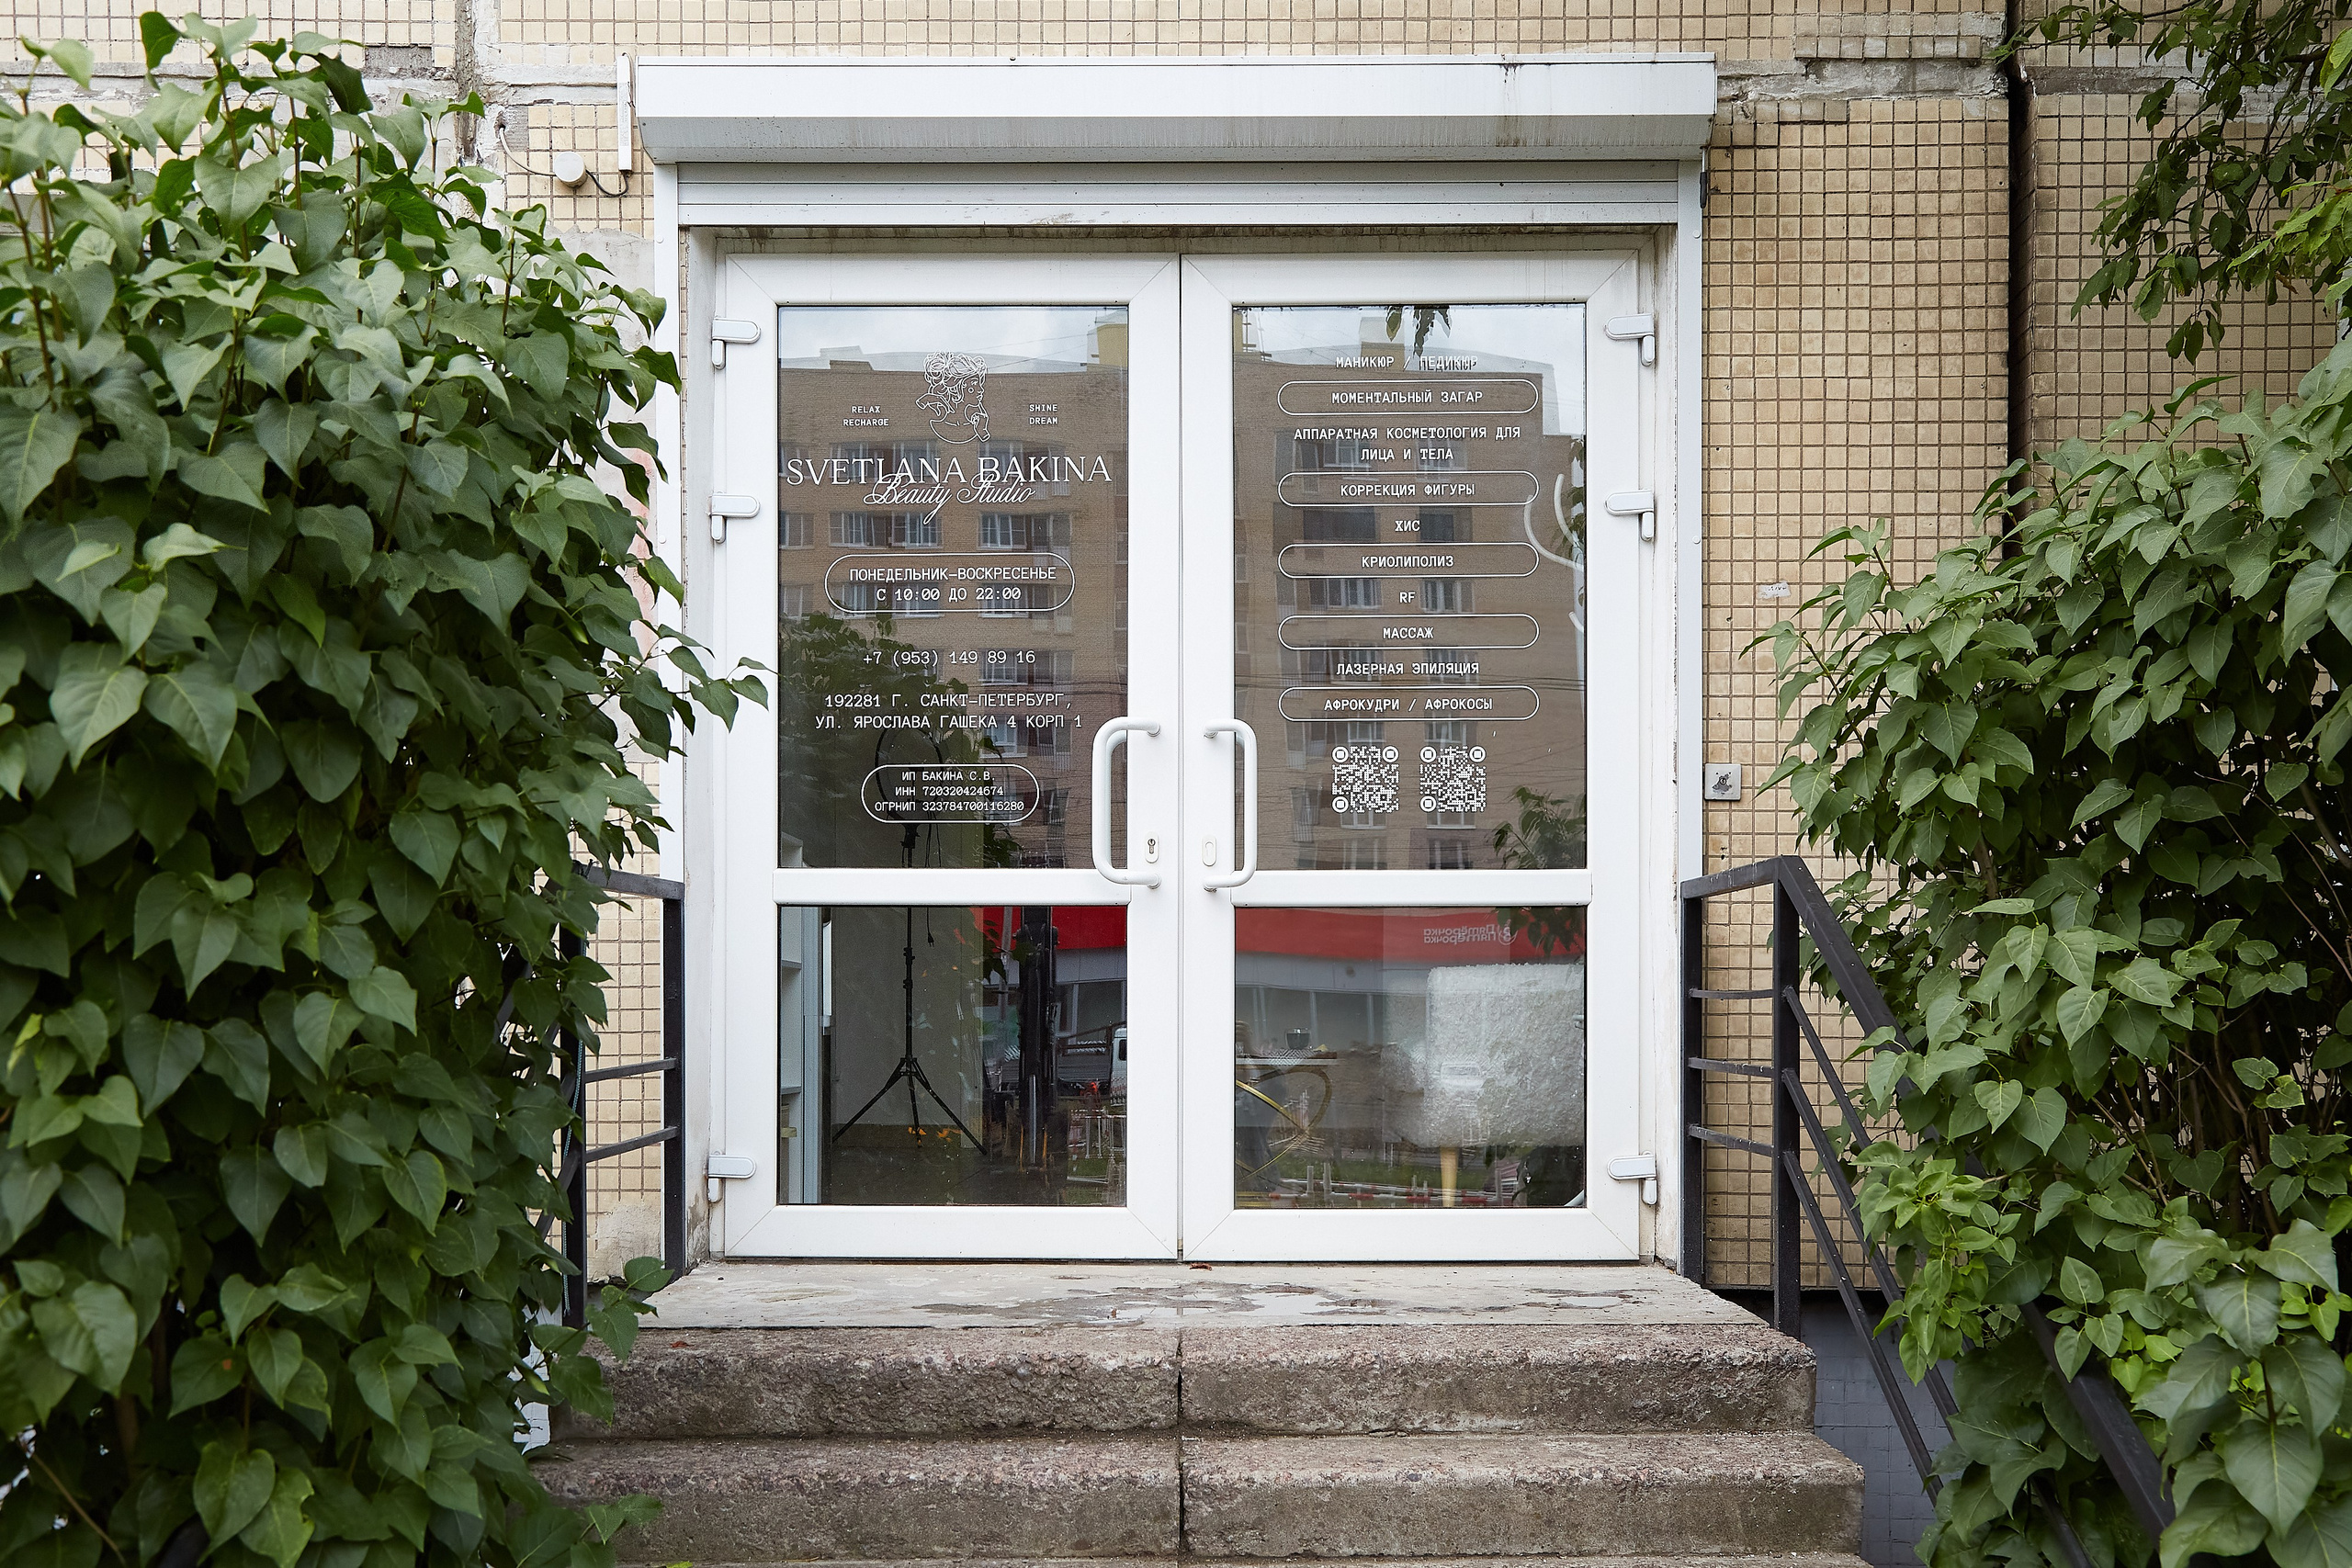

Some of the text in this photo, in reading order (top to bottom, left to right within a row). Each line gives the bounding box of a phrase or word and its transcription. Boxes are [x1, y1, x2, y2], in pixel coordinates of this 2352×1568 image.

[1336, 356, 1395, 368] МАНИКЮР
[1419, 355, 1478, 368] ПЕДИКЮР
[1331, 389, 1483, 404] МОМЕНТАЛЬНЫЙ ЗАГАР
[852, 406, 881, 414] RELAX
[1029, 404, 1058, 412] SHINE
[842, 418, 889, 427] RECHARGE
[1029, 417, 1058, 425] DREAM
[1294, 427, 1521, 441] АППАРАТНАЯ КОСМЕТОЛОГИЯ ДЛЯ
[1361, 448, 1453, 462] ЛИЦА И ТЕЛА
[786, 455, 1113, 487] SVETLANA BAKINA
[1340, 484, 1475, 498] КОРРЕКЦИЯ ФИГУРЫ
[863, 471, 1036, 525] Beauty Studio
[1395, 520, 1420, 532] ХИС
[1362, 556, 1454, 568] КРИОЛИПОЛИЗ
[876, 587, 1021, 603] С 10:00 ДО 22:00
[1399, 592, 1416, 604] RF
[1383, 626, 1434, 638] МАССАЖ
[863, 650, 1035, 667] +7 (953) 149 89 16
[1336, 662, 1479, 676] ЛАЗЕРНАЯ ЭПИЛЯЦИЯ
[825, 694, 881, 707] 192281
[891, 694, 910, 707] Г.
[1324, 698, 1400, 712] АФРОКУДРИ
[1425, 698, 1493, 710] АФРОКОСЫ
[815, 715, 1082, 729] УЛ. ЯРОСЛАВА ГАШЕКА 4 КОРП 1
[901, 771, 996, 781] ИП БАКИНА С.В.
[895, 785, 1003, 796] ИНН 720320424674
[875, 801, 1024, 812] ОГРНИП 323784700116280
